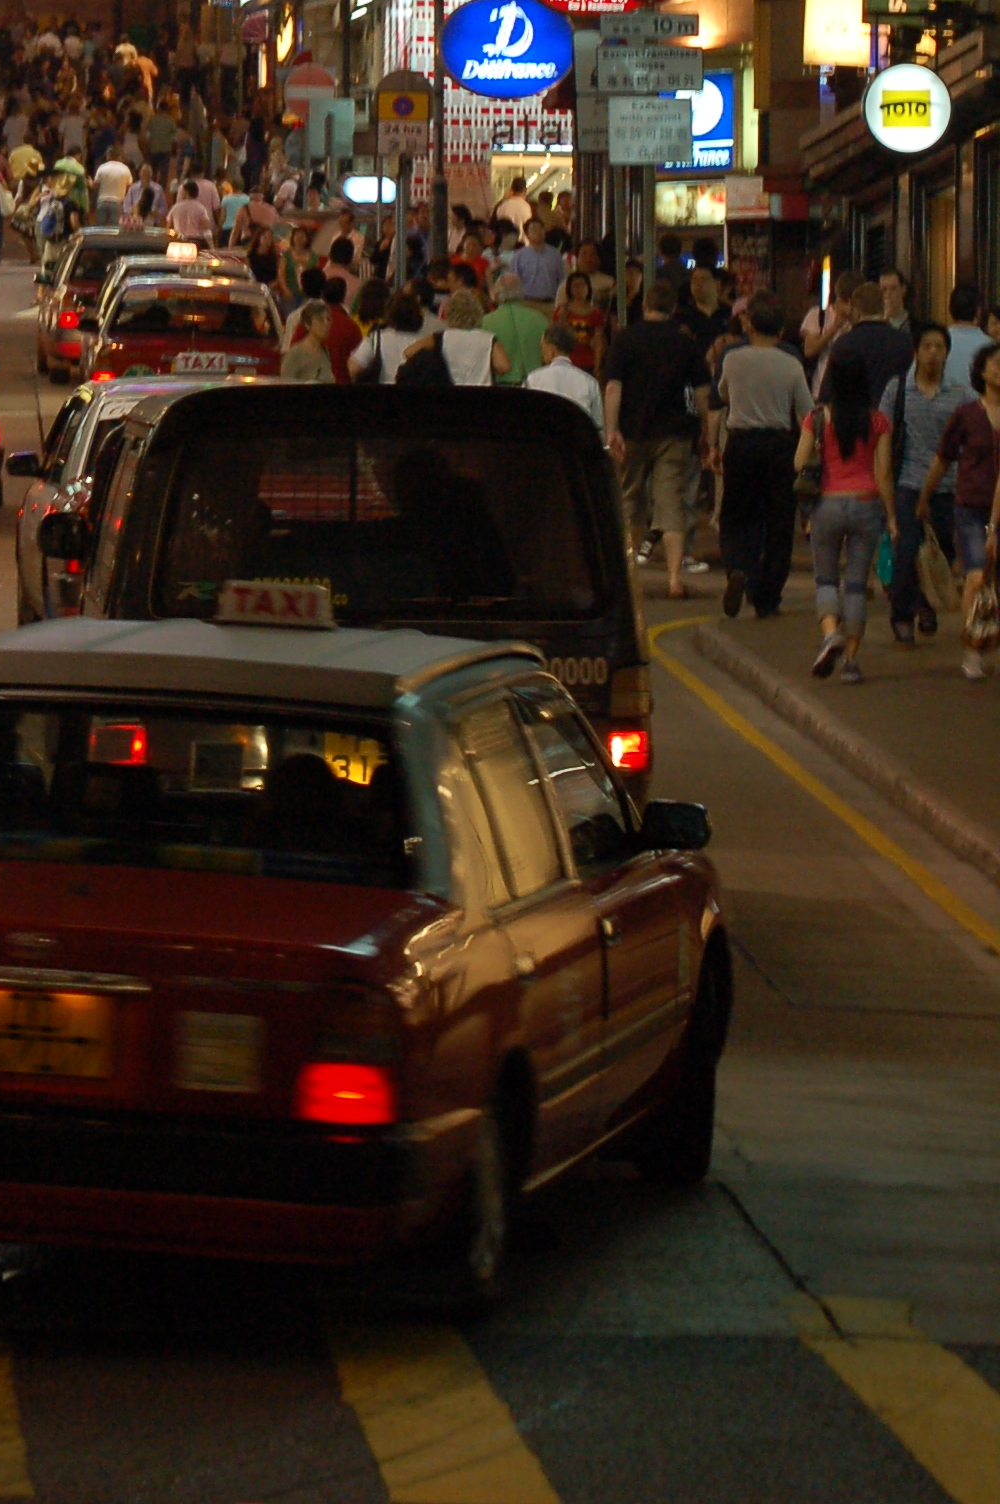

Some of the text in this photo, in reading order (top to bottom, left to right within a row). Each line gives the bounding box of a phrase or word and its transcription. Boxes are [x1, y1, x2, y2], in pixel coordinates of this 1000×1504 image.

[653, 16, 695, 34] 10 m
[181, 355, 225, 372] TAXI
[231, 586, 319, 619] TAXI
